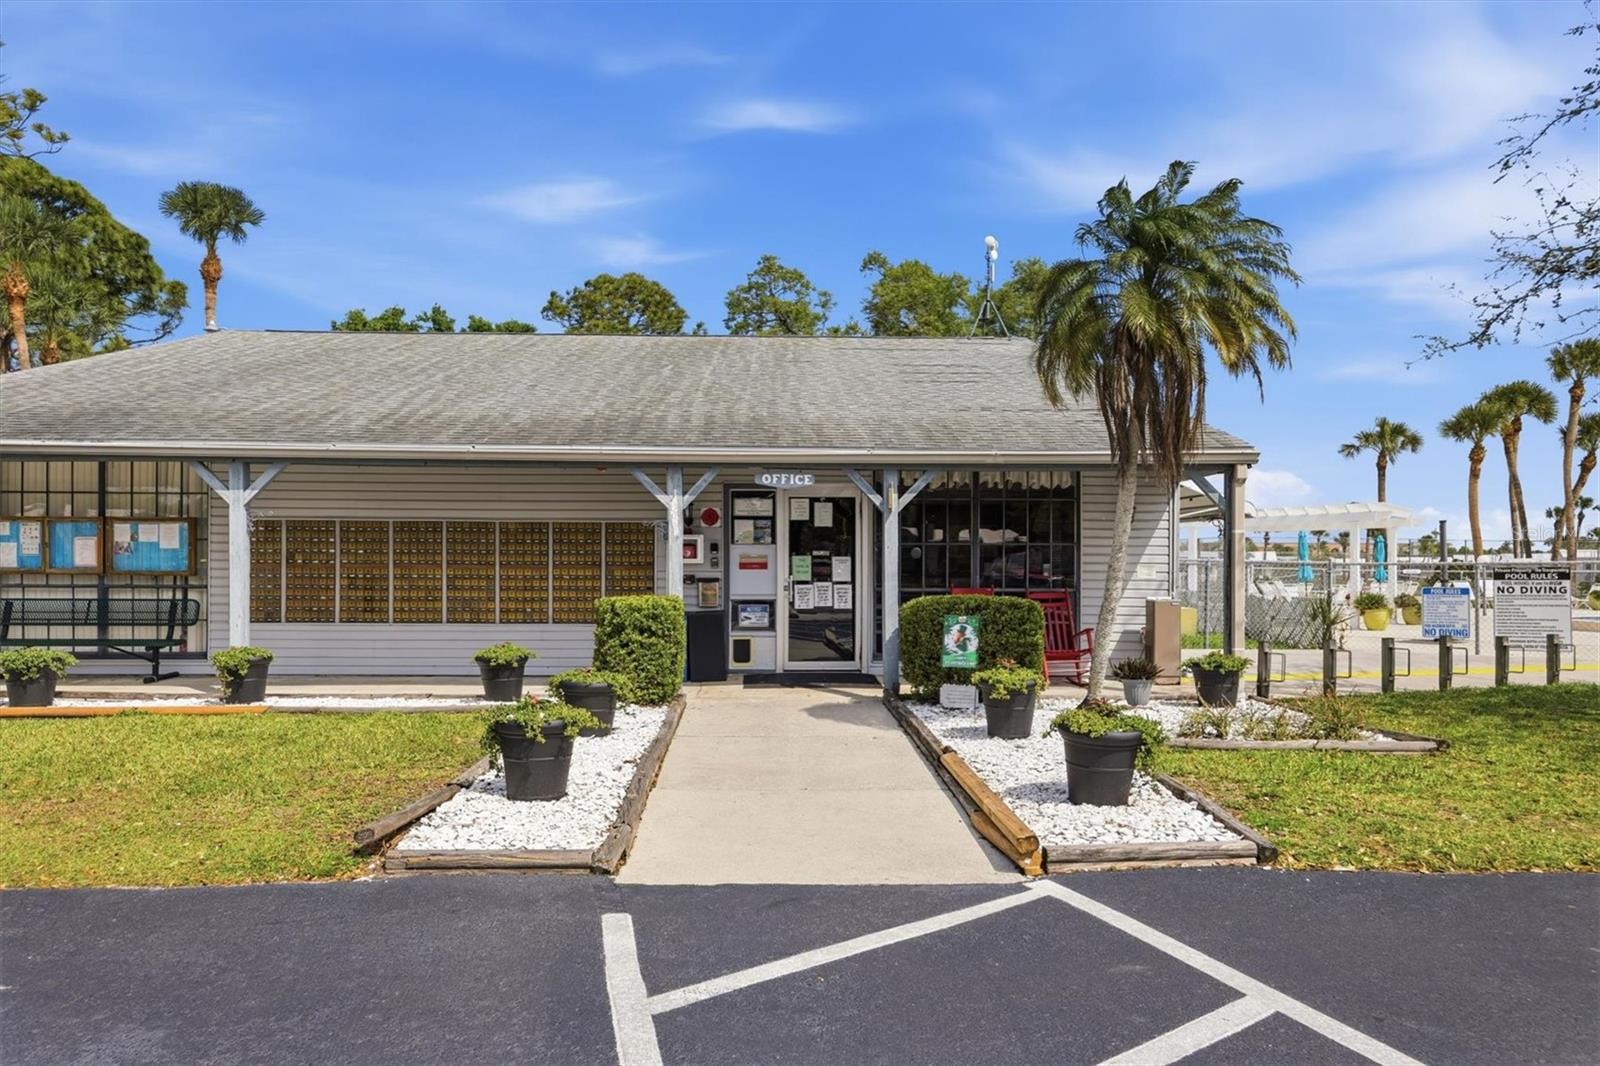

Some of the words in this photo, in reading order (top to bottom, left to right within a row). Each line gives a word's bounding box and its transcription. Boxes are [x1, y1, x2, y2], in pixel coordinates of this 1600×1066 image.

[762, 473, 813, 486] OFFICE
[1497, 586, 1516, 594] NO
[1520, 586, 1568, 594] DIVING
[1424, 628, 1437, 637] NO
[1439, 628, 1468, 637] DIVING
